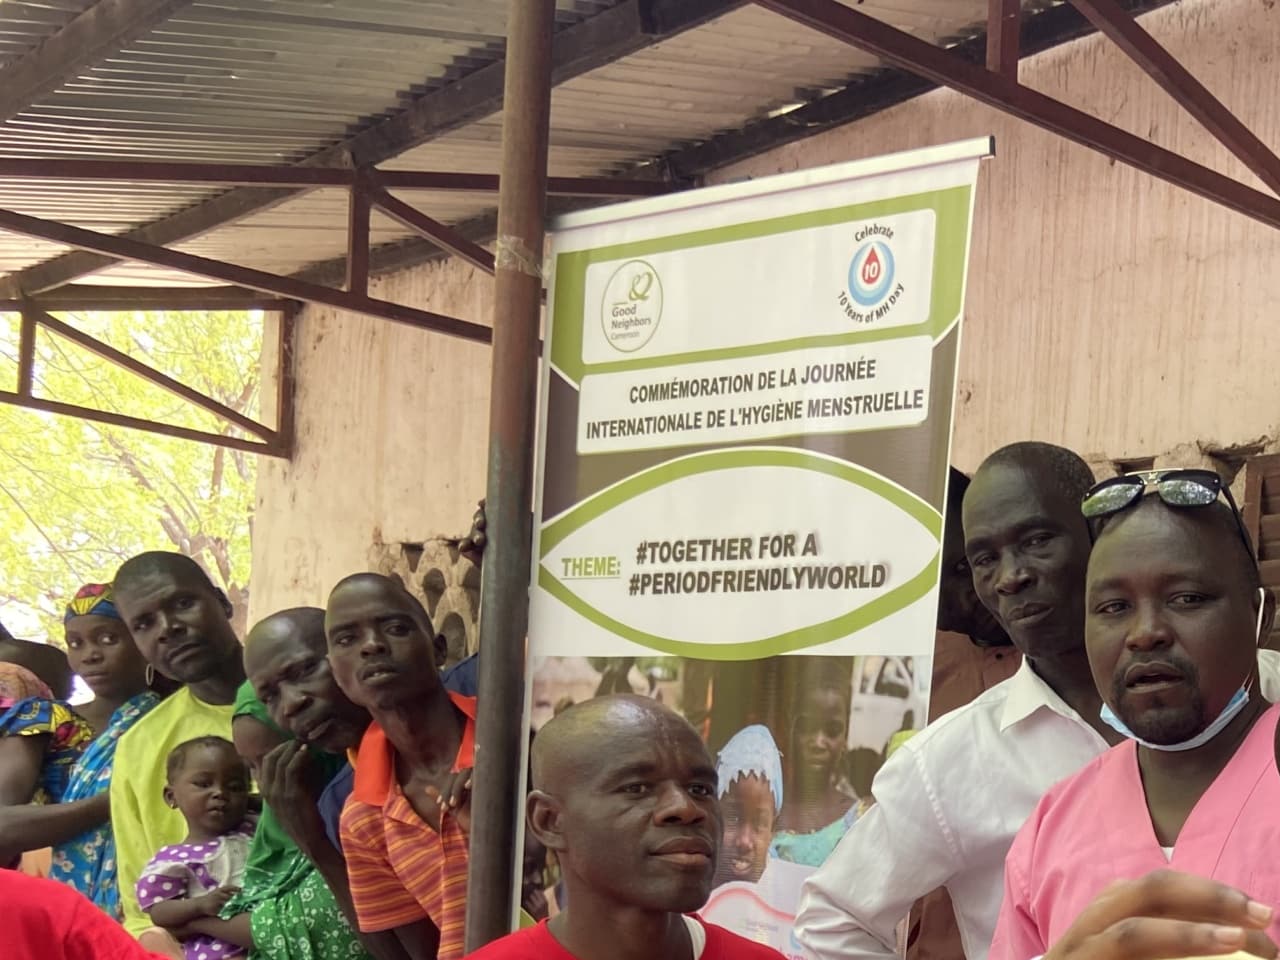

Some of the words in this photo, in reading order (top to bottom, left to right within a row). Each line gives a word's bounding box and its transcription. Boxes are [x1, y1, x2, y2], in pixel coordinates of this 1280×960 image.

[855, 223, 894, 242] Celebrate
[864, 261, 879, 281] 10
[612, 304, 637, 317] Good
[838, 291, 847, 306] 10
[844, 303, 863, 323] Years
[865, 310, 874, 323] of
[875, 302, 890, 320] MH
[889, 283, 905, 305] Day
[611, 317, 651, 330] Neighbors
[629, 373, 753, 404] COMMÉMORATION
[757, 370, 776, 391] DE
[780, 368, 797, 388] LA
[801, 356, 876, 385] JOURNÉE
[586, 411, 703, 440] INTERNATIONALE
[706, 409, 726, 429] DE
[730, 399, 803, 427] L'HYGIÈNE
[807, 389, 924, 418] MENSTRUELLE
[636, 537, 752, 565] #TOGETHER
[759, 534, 796, 559] FOR
[801, 533, 817, 557] A
[562, 556, 621, 577] THEME:
[629, 564, 886, 596] #PERIODFRIENDLYWORLD
